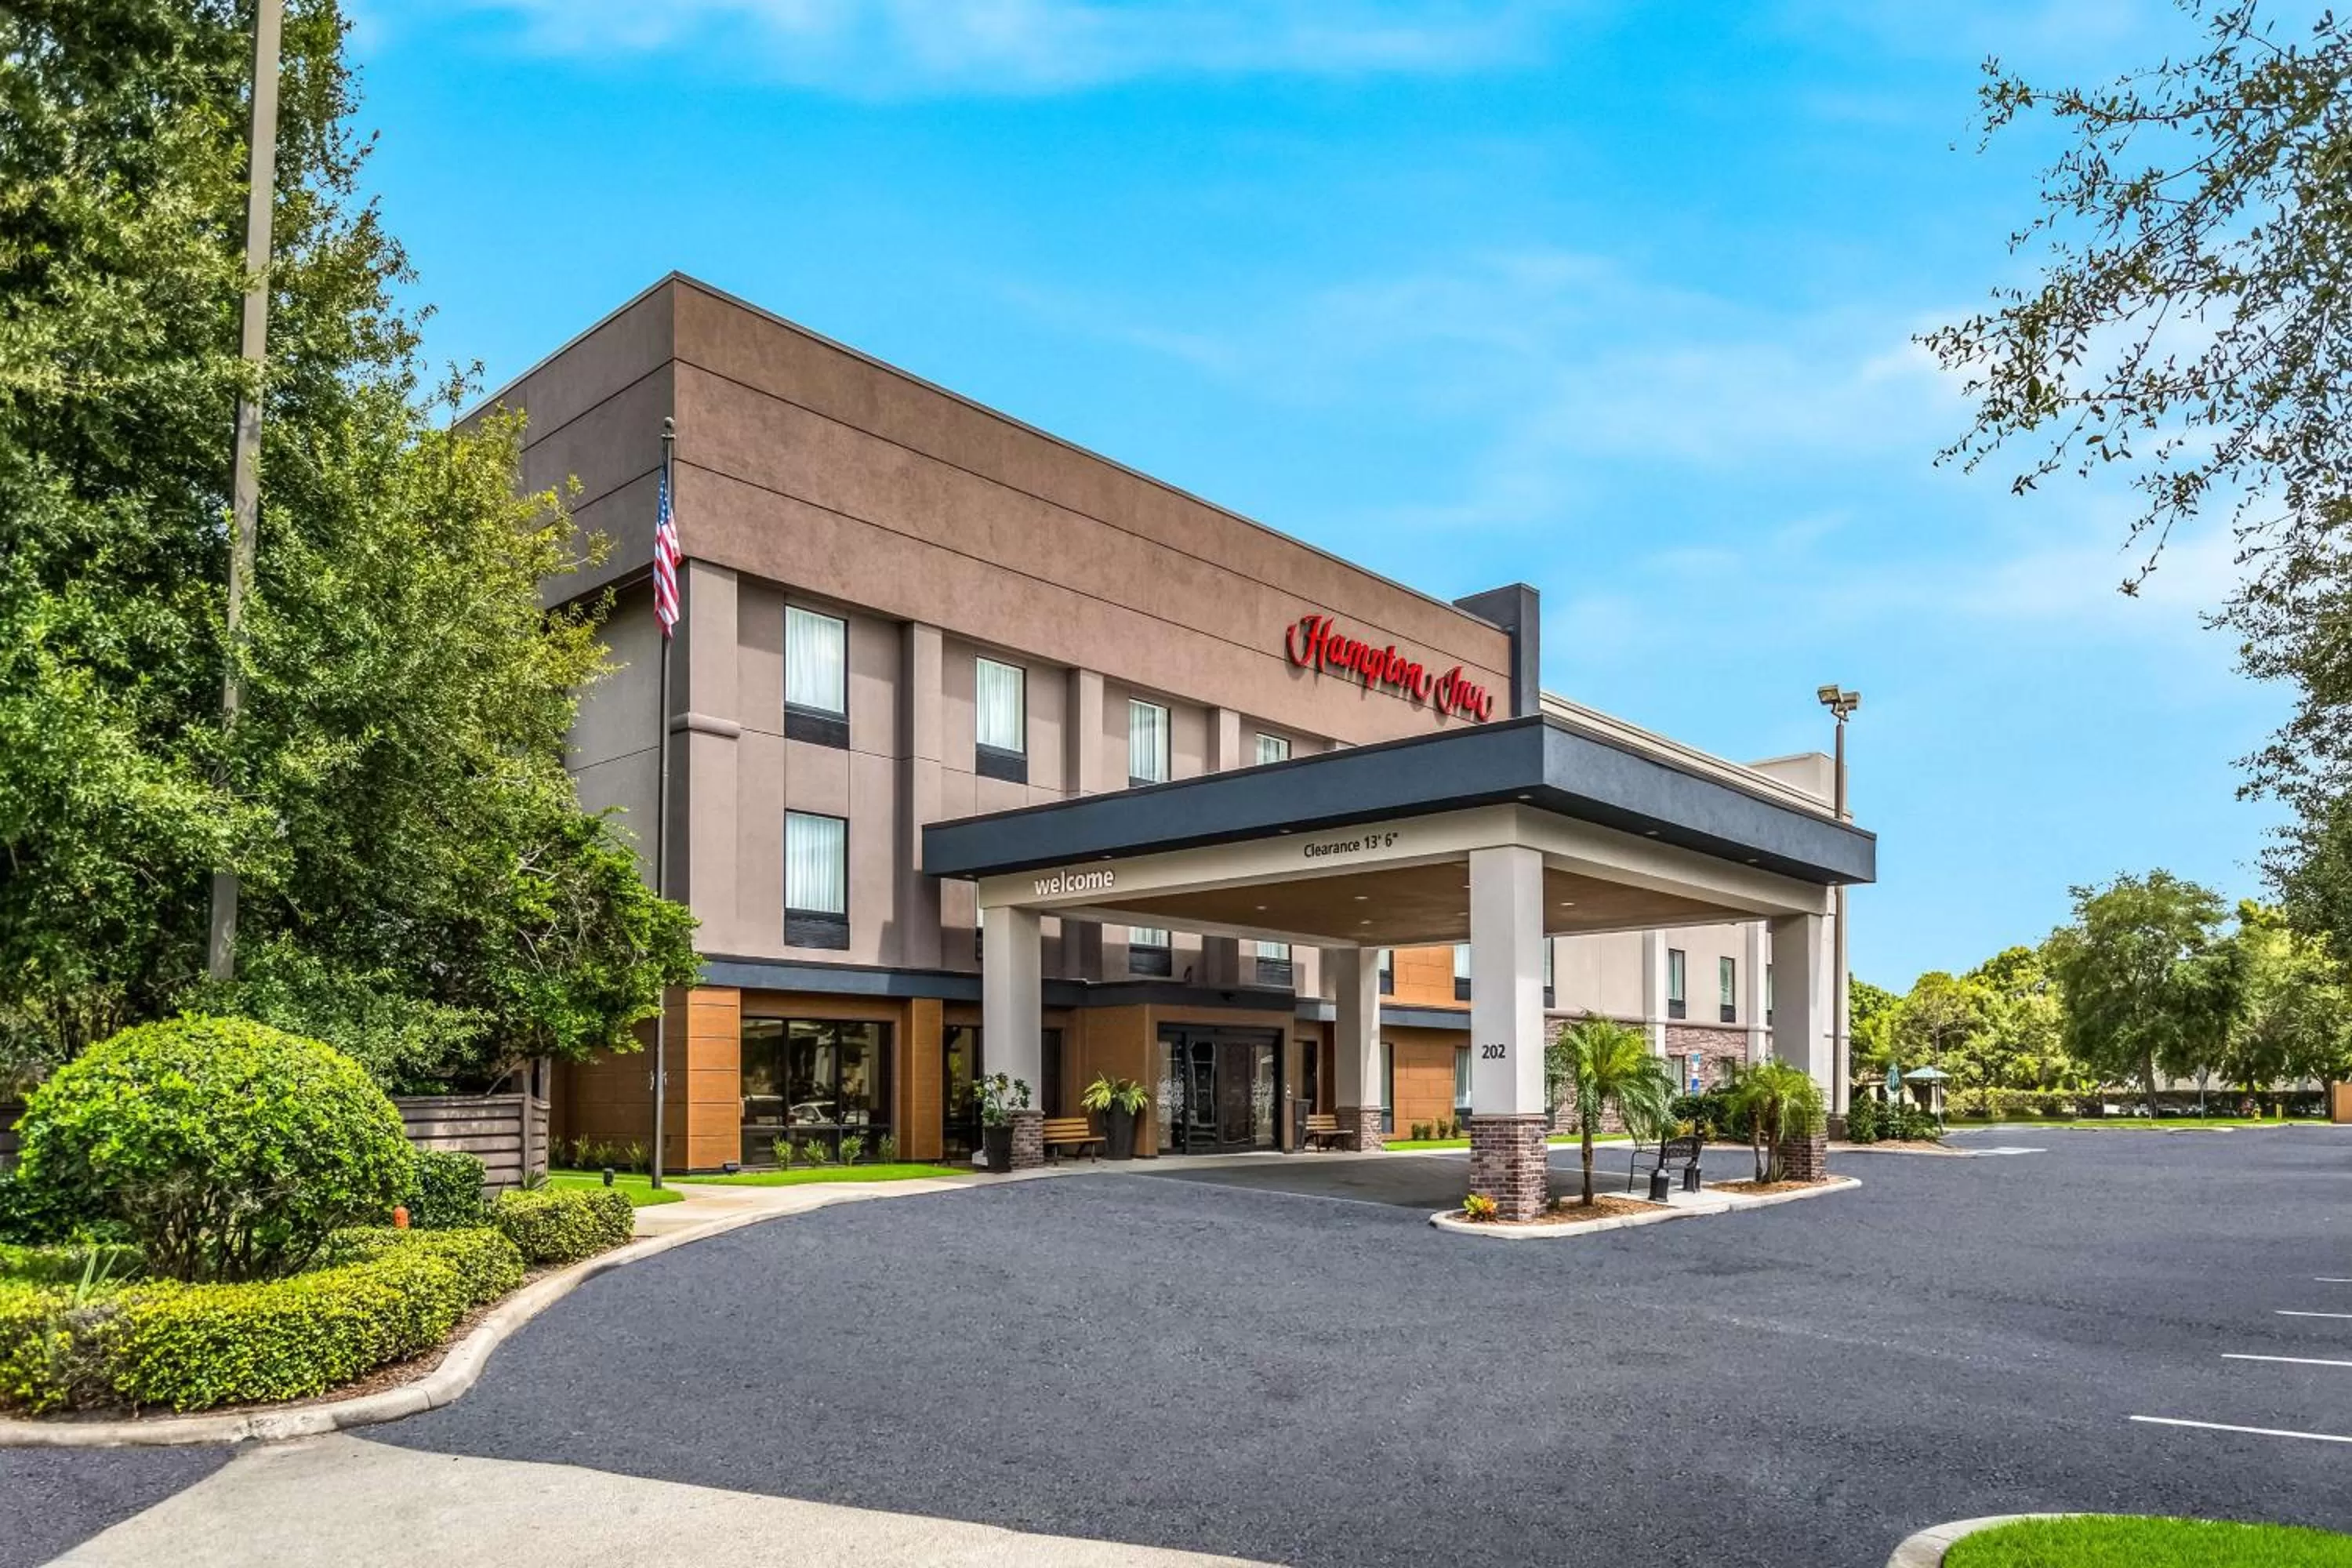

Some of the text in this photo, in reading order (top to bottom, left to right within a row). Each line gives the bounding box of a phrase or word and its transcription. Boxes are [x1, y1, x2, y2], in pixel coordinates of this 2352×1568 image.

[1286, 615, 1493, 721] Hampton Inn
[1304, 841, 1360, 857] Clearance
[1364, 834, 1381, 849] 13'
[1035, 870, 1114, 895] welcome
[1481, 1044, 1506, 1059] 202
